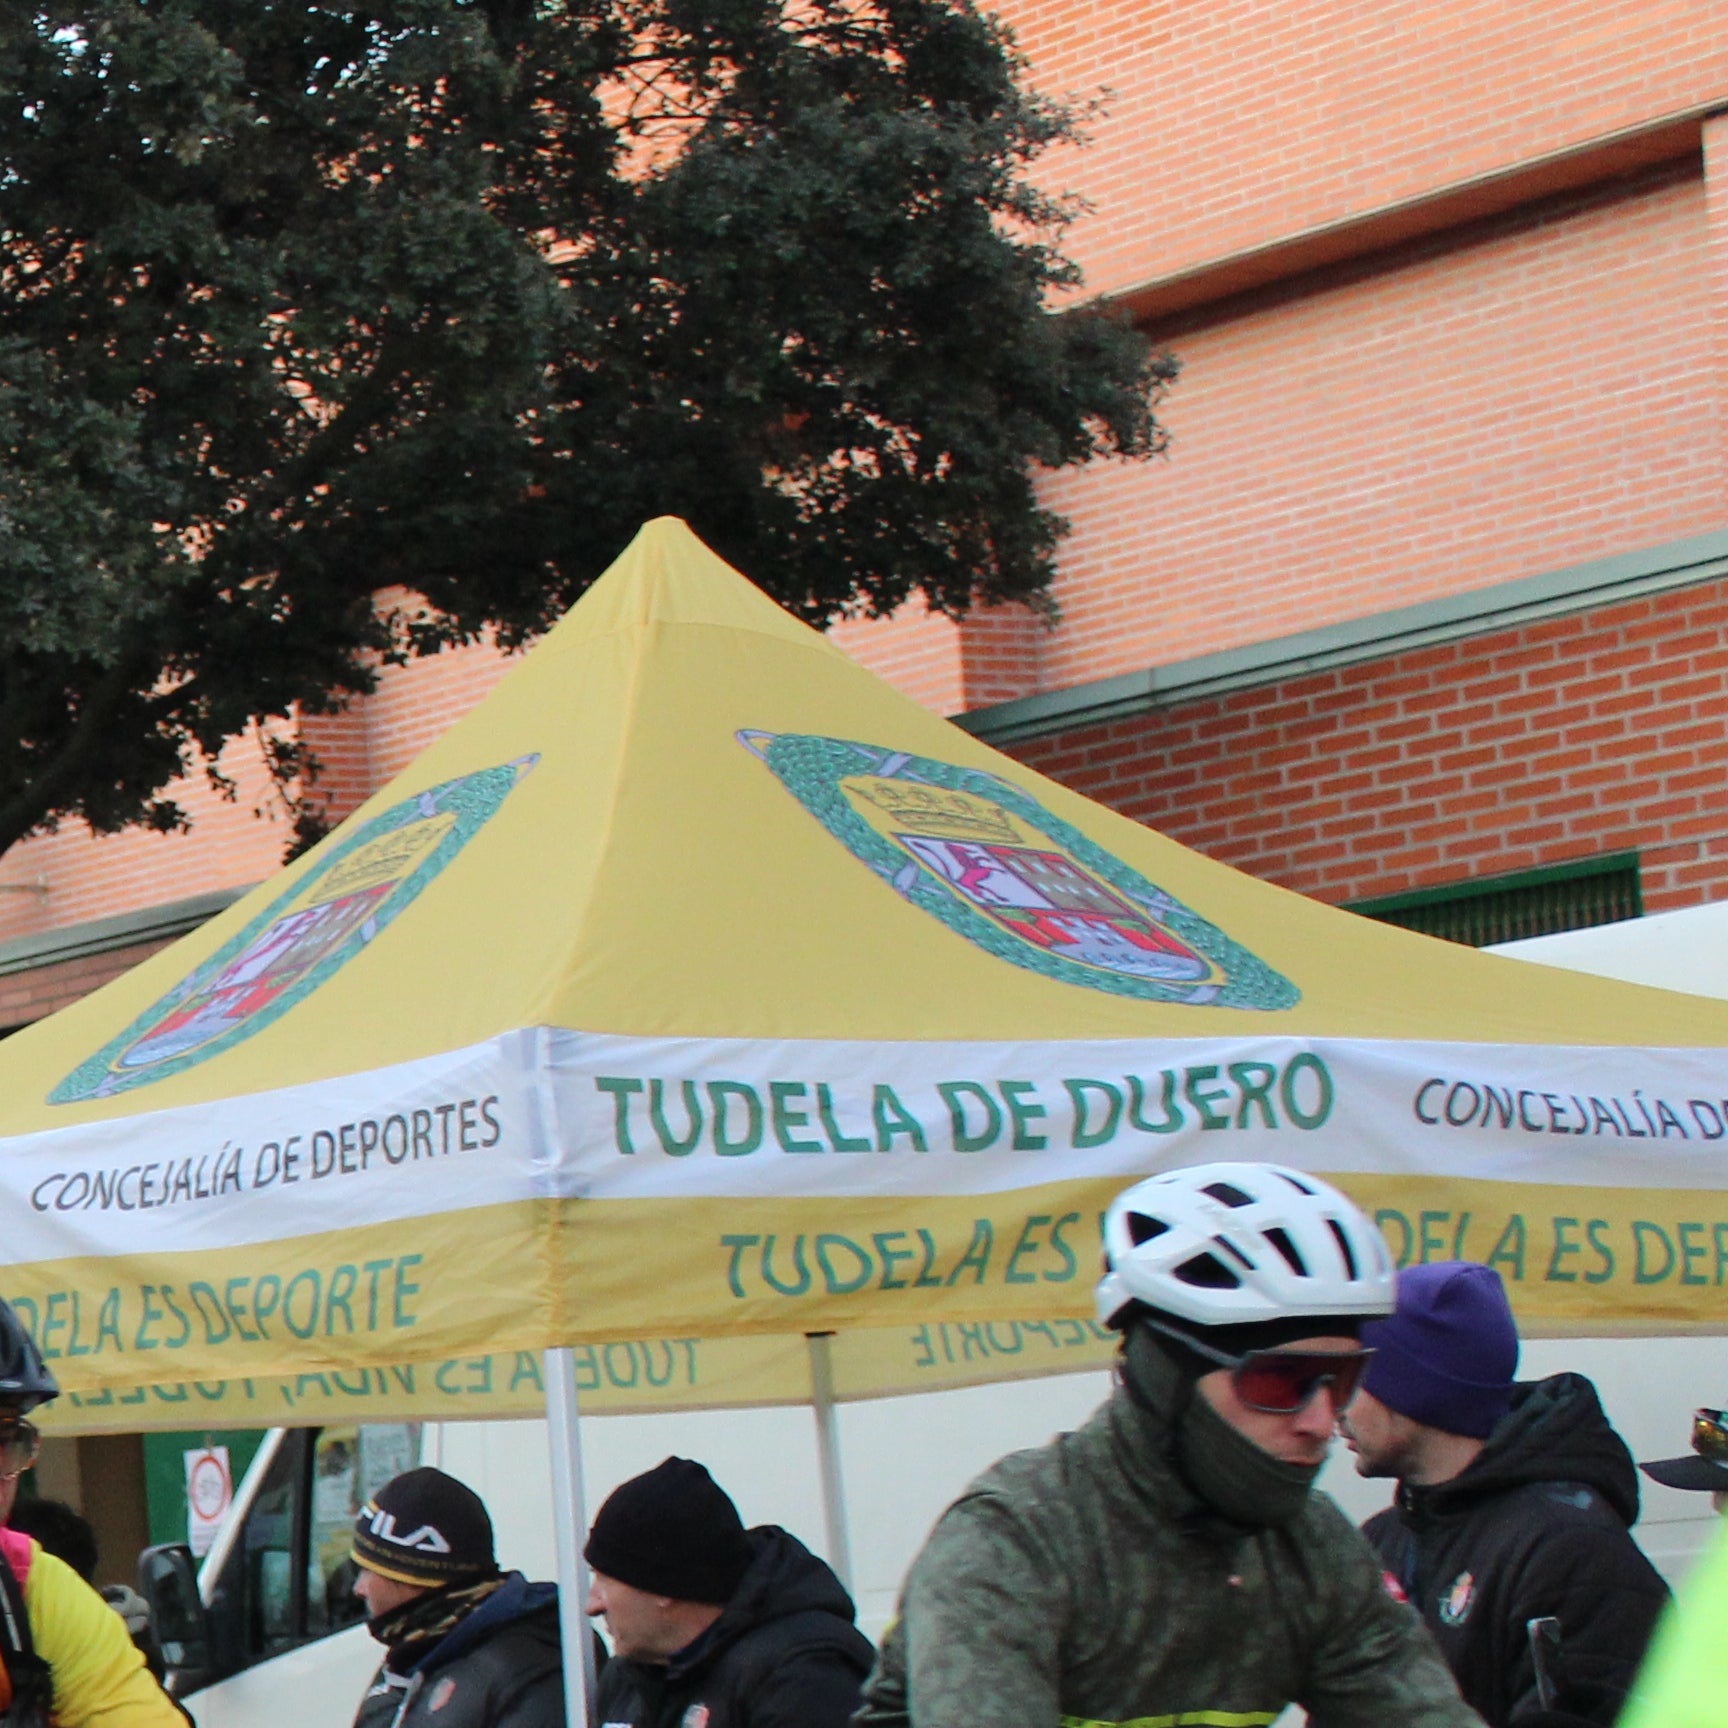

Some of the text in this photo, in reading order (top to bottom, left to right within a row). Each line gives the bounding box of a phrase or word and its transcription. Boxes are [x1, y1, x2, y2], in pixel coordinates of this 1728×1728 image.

[595, 1052, 1335, 1157] TUDELA DE DUERO
[1414, 1078, 1728, 1140] CONCEJALÍA D
[30, 1094, 502, 1212] CONCEJALÍA DE DEPORTES
[720, 1211, 1081, 1298] TUDELA ES
[1546, 1217, 1616, 1284] ES
[135, 1283, 192, 1350] ES
[191, 1253, 424, 1347] DEPORTE
